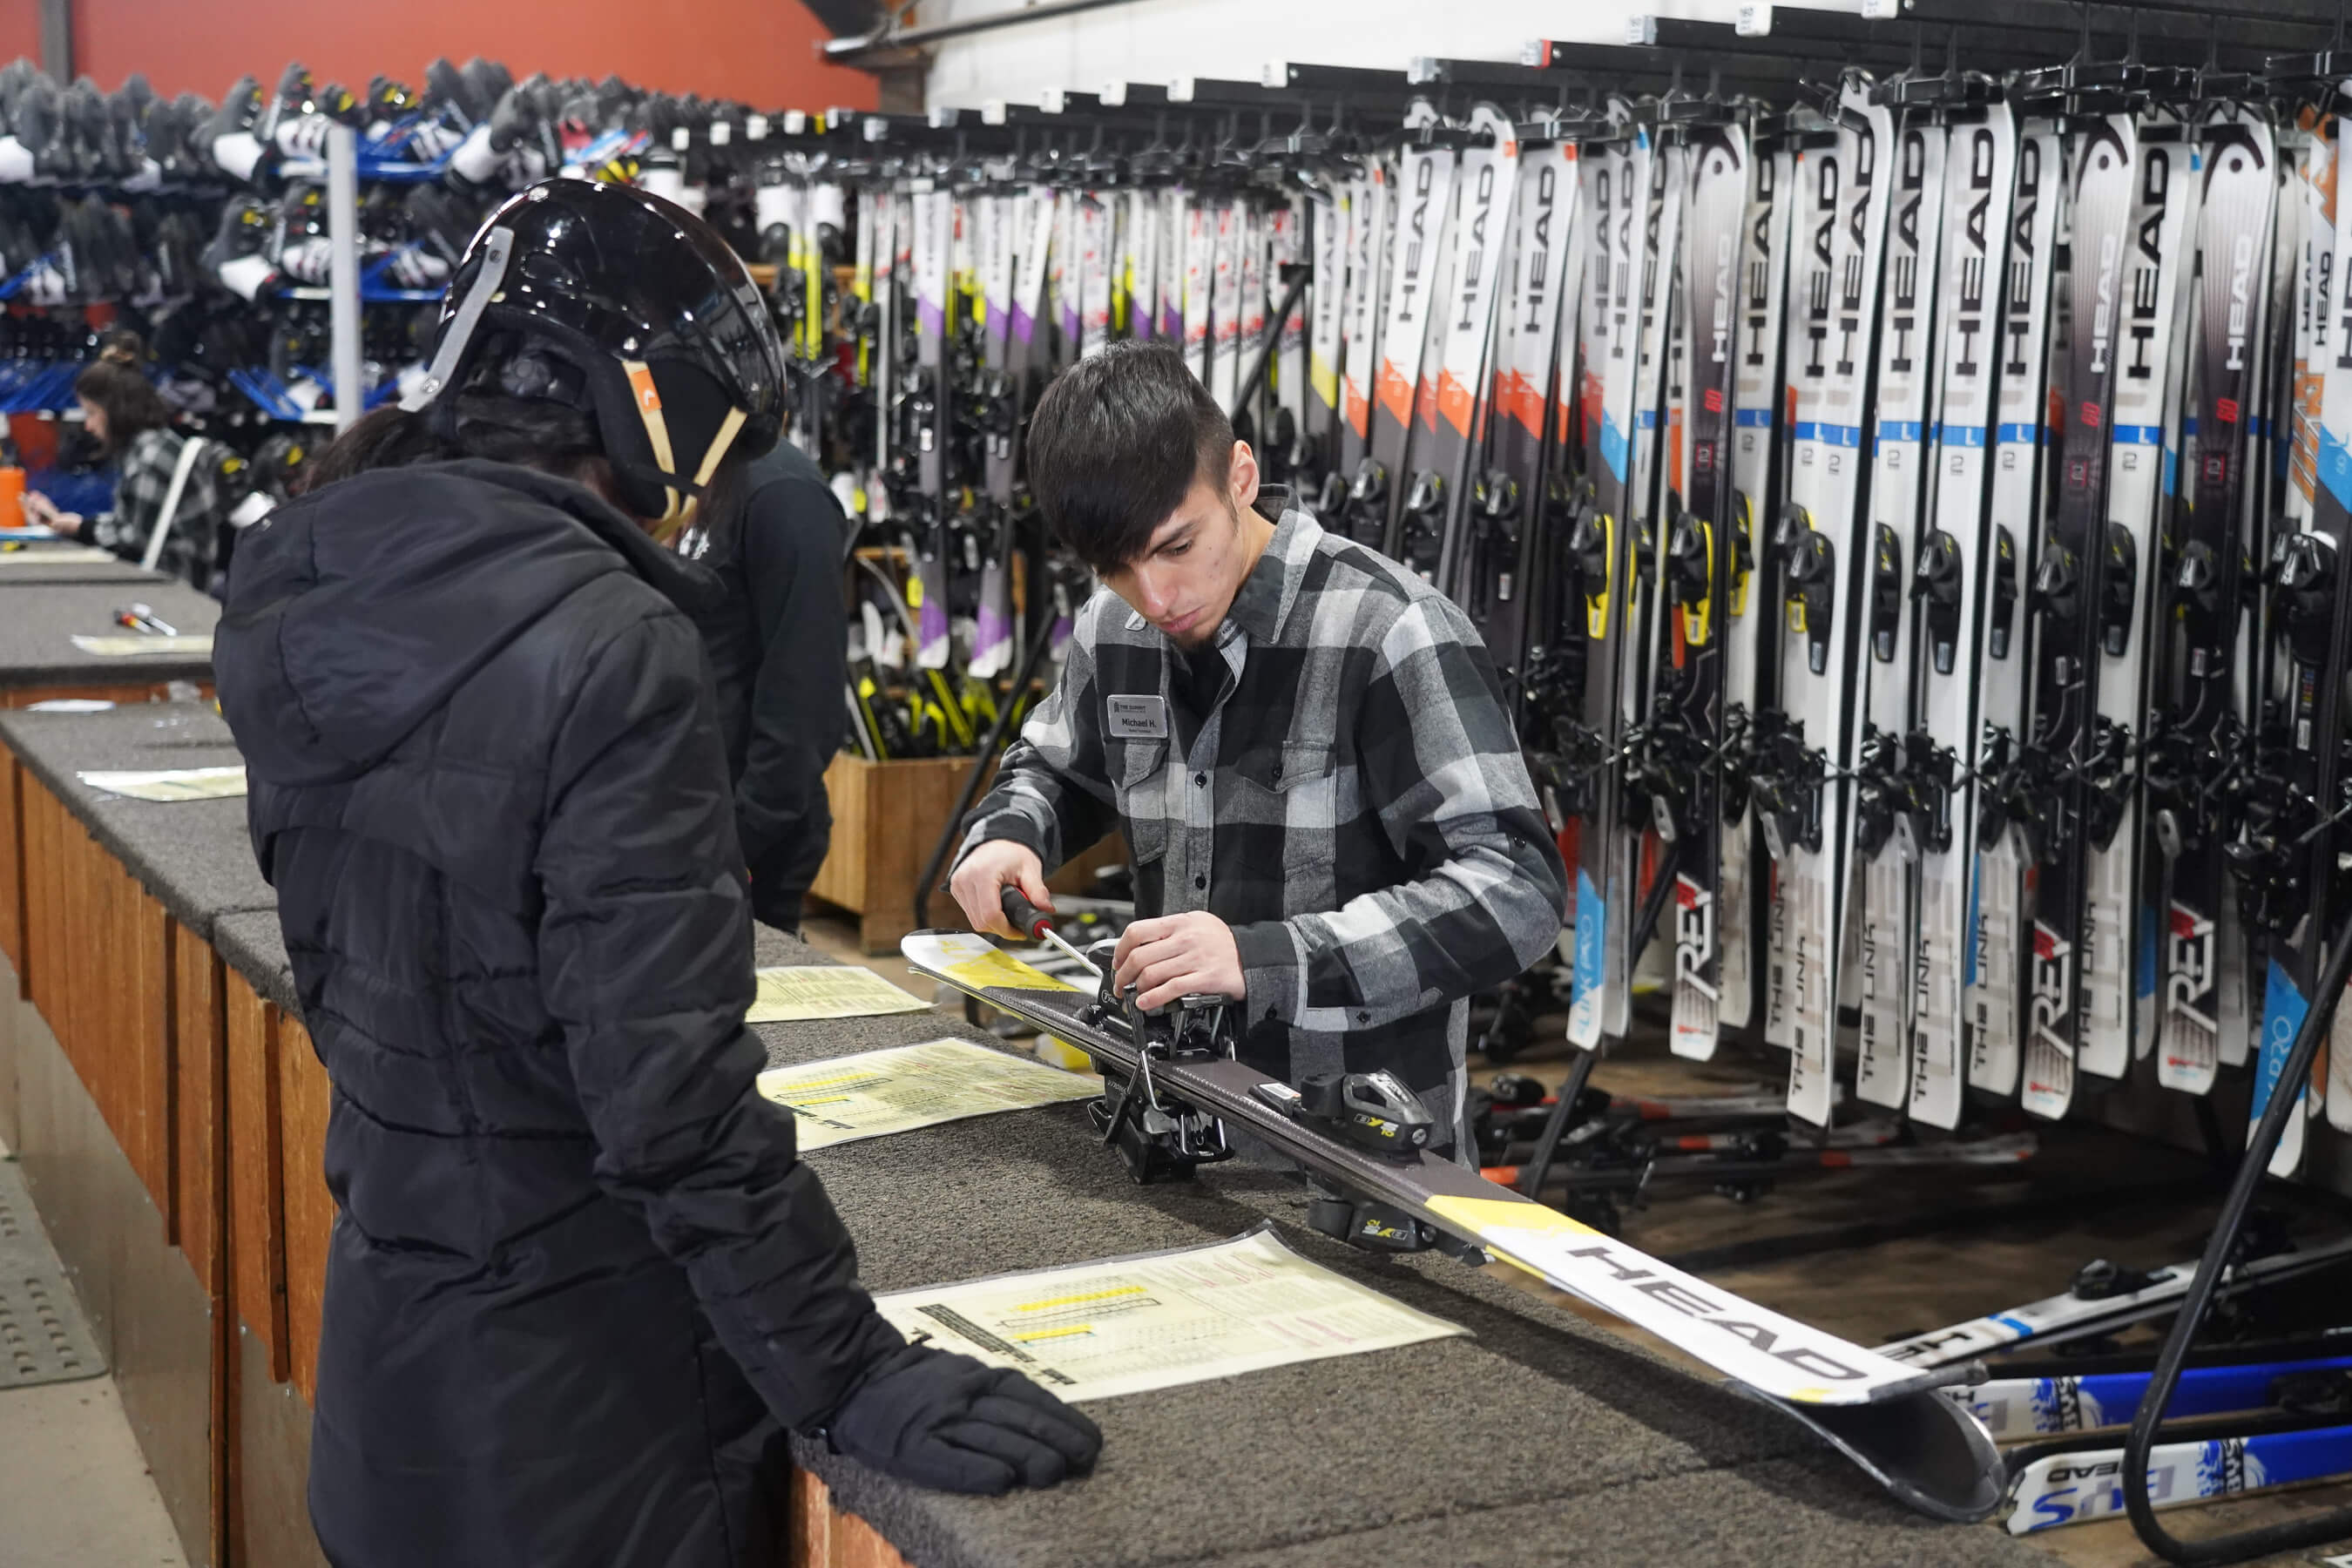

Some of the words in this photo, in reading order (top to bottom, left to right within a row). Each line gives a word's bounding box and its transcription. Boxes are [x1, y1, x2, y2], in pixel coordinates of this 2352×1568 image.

[1355, 189, 1372, 342] HEAD
[1398, 157, 1434, 321] HEAD
[1457, 163, 1495, 331] HEAD
[1524, 165, 1555, 334] HEAD
[1594, 168, 1610, 336] HEAD
[1612, 159, 1634, 358] HEAD
[1712, 233, 1732, 362] HEAD
[1747, 152, 1775, 366] HEAD
[1805, 156, 1839, 377] HEAD
[1836, 127, 1876, 375] HEAD
[1890, 130, 1925, 373] HEAD
[1956, 128, 1995, 376] HEAD
[2005, 138, 2040, 375] HEAD
[2091, 233, 2116, 373] HEAD
[2127, 147, 2169, 379] HEAD
[2226, 233, 2252, 370] HEAD
[2315, 251, 2332, 347] HEAD
[1842, 428, 1851, 445] L
[1902, 423, 1912, 440] L
[1965, 428, 1976, 445] L
[2017, 424, 2027, 442] L
[2139, 427, 2151, 444] L
[2215, 397, 2238, 423] 60
[1122, 718, 1147, 727] Michael
[1149, 719, 1157, 728] H.
[1676, 872, 1718, 1001] REV
[1769, 964, 1782, 1028] THE
[1795, 936, 1806, 1015] LINK
[1863, 923, 1876, 1002] LINK
[1917, 939, 1931, 1018] LINK
[1976, 915, 1989, 990] LINK
[2031, 918, 2074, 1059] REV
[2167, 900, 2218, 1034] REV
[1792, 1025, 1805, 1096] THE
[1862, 1013, 1876, 1083] THE
[1914, 1031, 1929, 1102] THE
[1974, 1003, 1988, 1071] THE
[1569, 1246, 1869, 1380] HEAD
[2047, 1461, 2119, 1483] EAD
